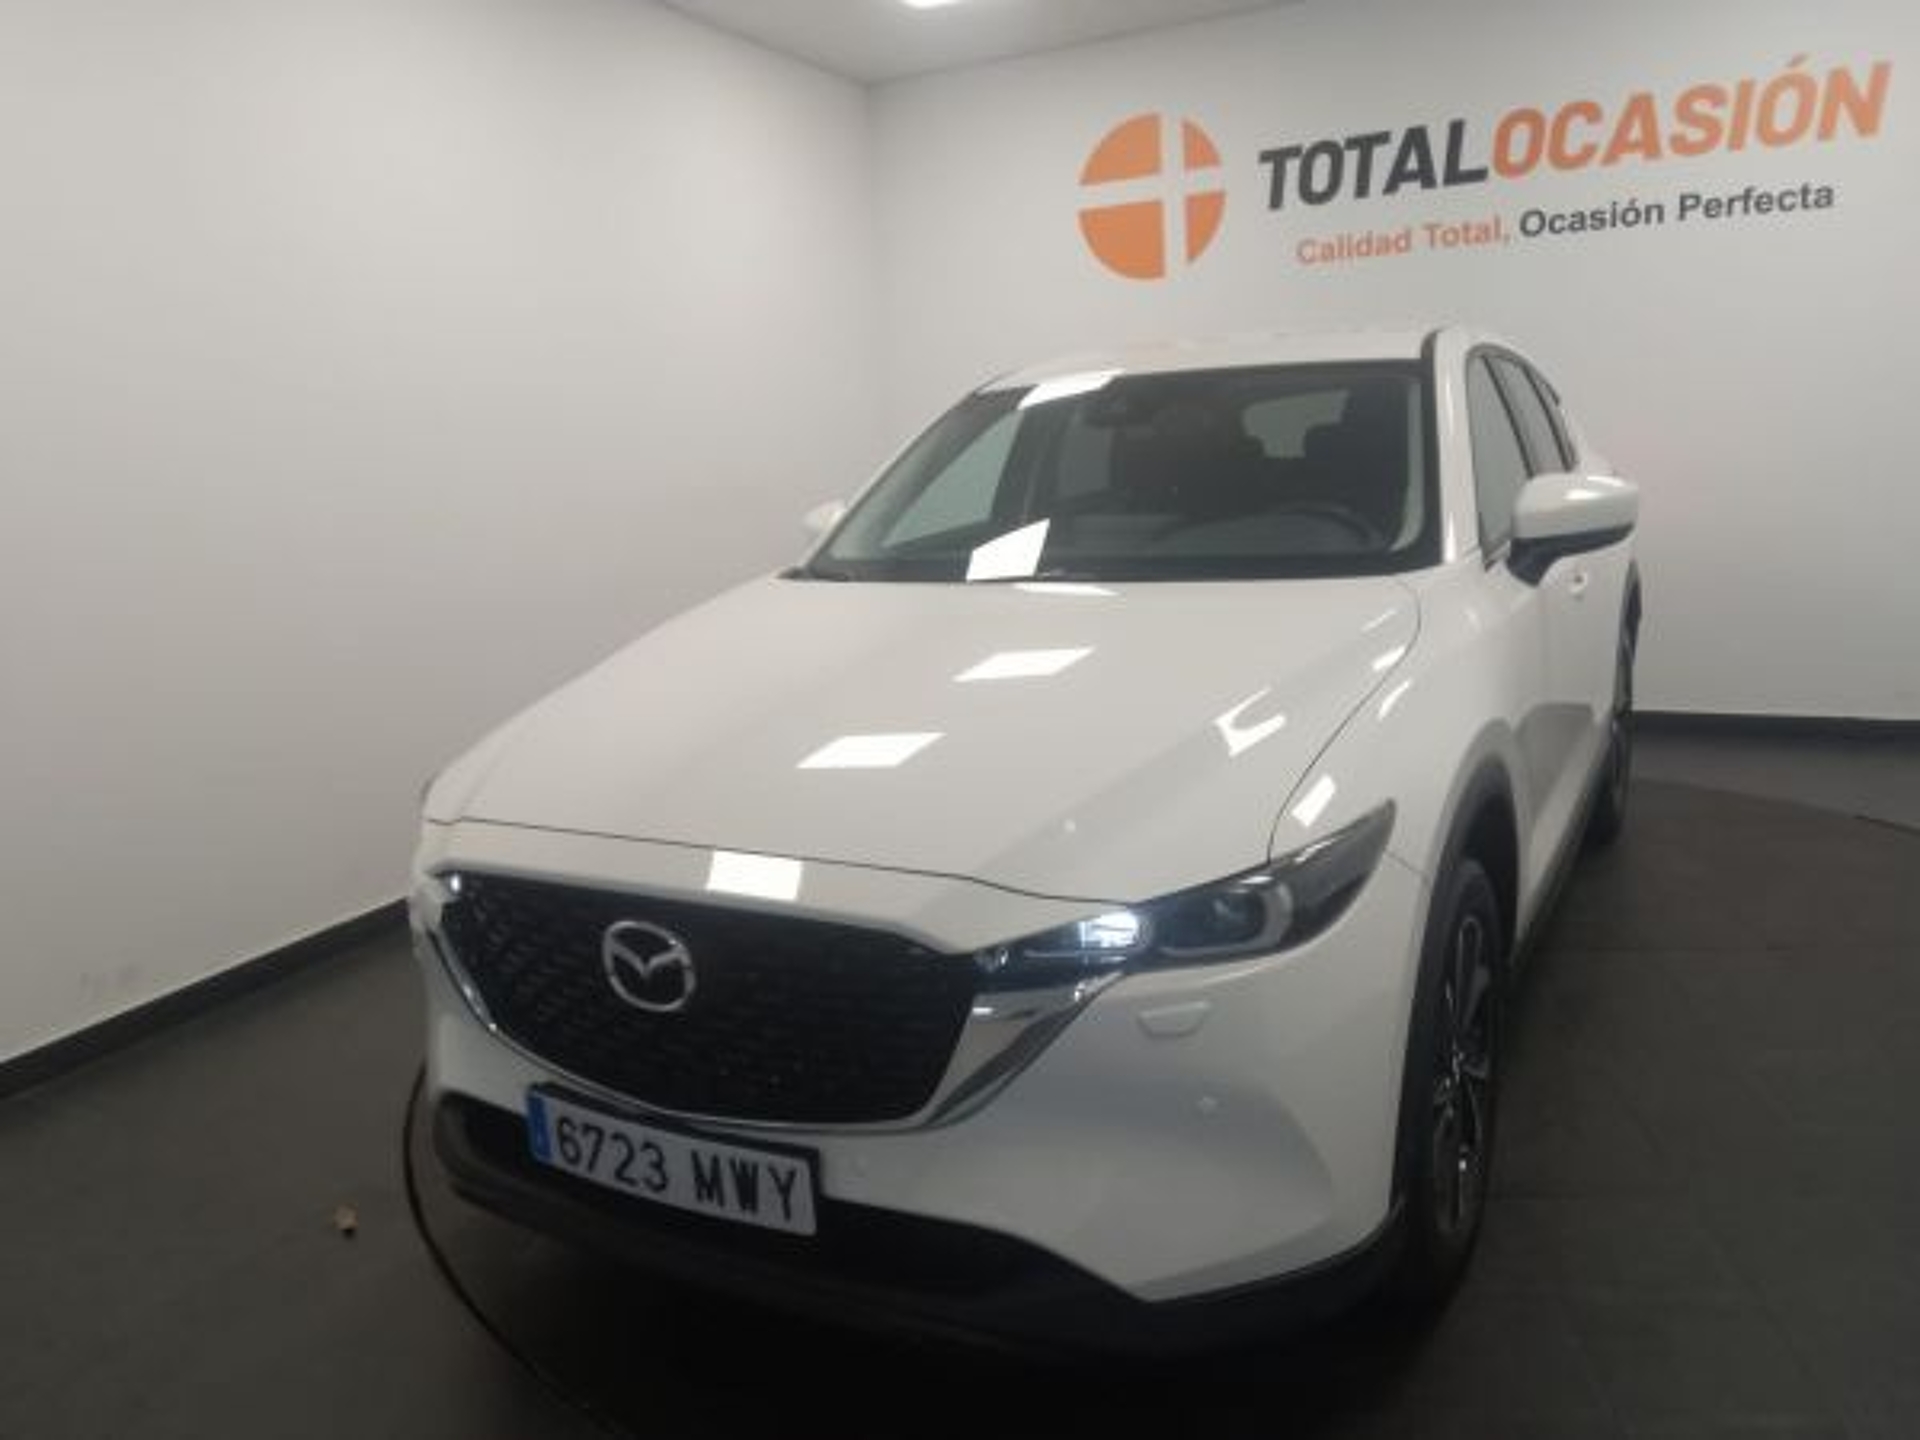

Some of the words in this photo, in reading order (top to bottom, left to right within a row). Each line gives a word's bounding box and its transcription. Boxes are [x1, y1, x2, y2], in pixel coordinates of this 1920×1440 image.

[1296, 229, 1412, 265] Calidad
[1422, 217, 1511, 250] Total,
[1519, 198, 1665, 238] Ocasión
[1677, 183, 1836, 221] Perfecta
[556, 1116, 669, 1192] 6723
[690, 1150, 797, 1221] MWY
